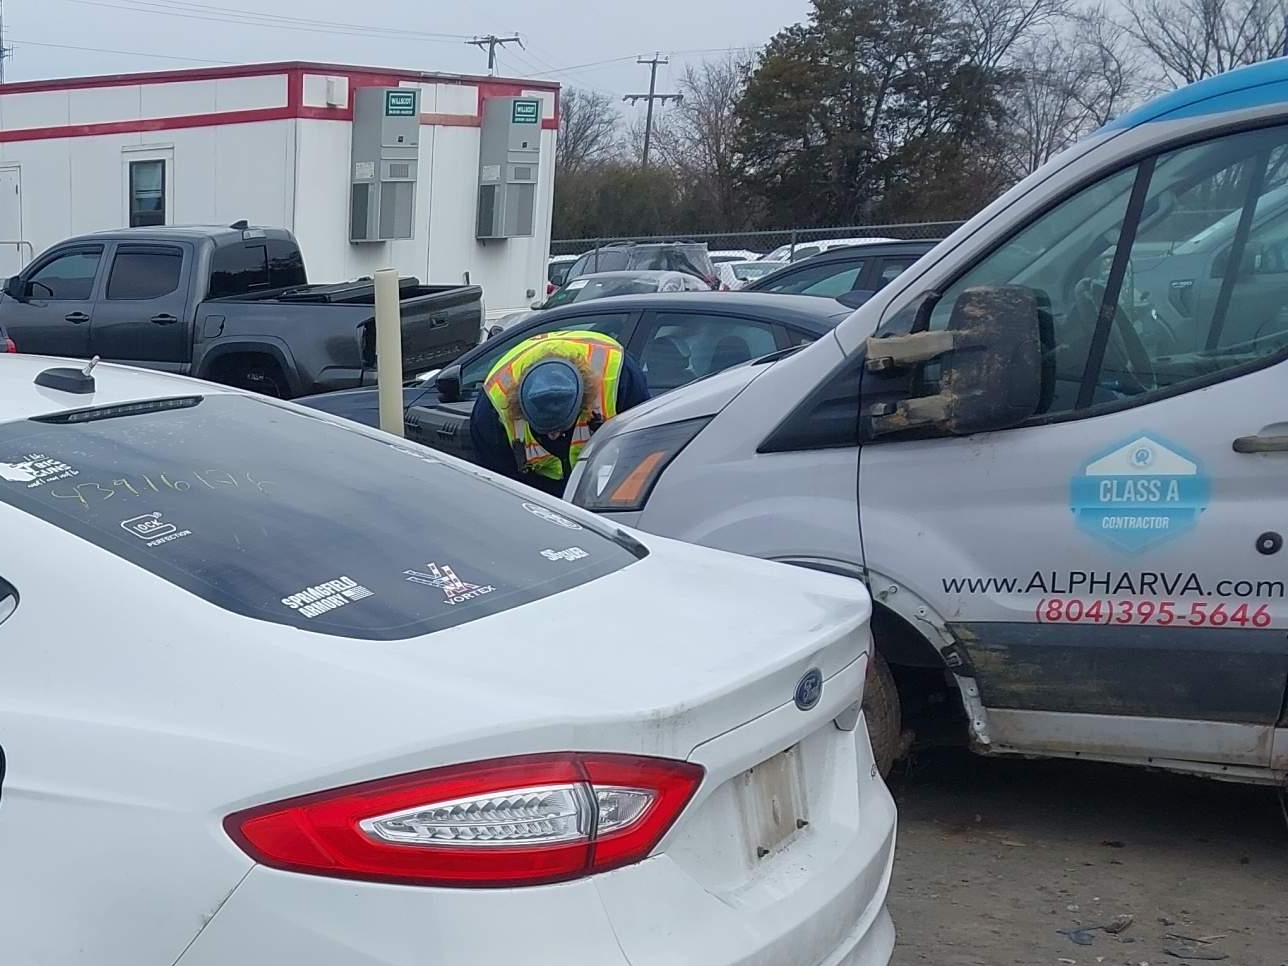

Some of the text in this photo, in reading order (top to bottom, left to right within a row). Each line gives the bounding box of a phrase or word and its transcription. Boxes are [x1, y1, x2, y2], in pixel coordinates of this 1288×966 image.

[1100, 480, 1179, 502] CLASS A
[1102, 516, 1170, 529] CONTRACTOR
[147, 530, 192, 547] PERFECTION
[280, 575, 358, 609] SPRINGFIELD
[443, 584, 497, 605] VORTEX
[942, 571, 1285, 597] www.ALPHARVA.com
[297, 590, 350, 618] ARMORY
[1035, 599, 1272, 627] (804)395-5646
